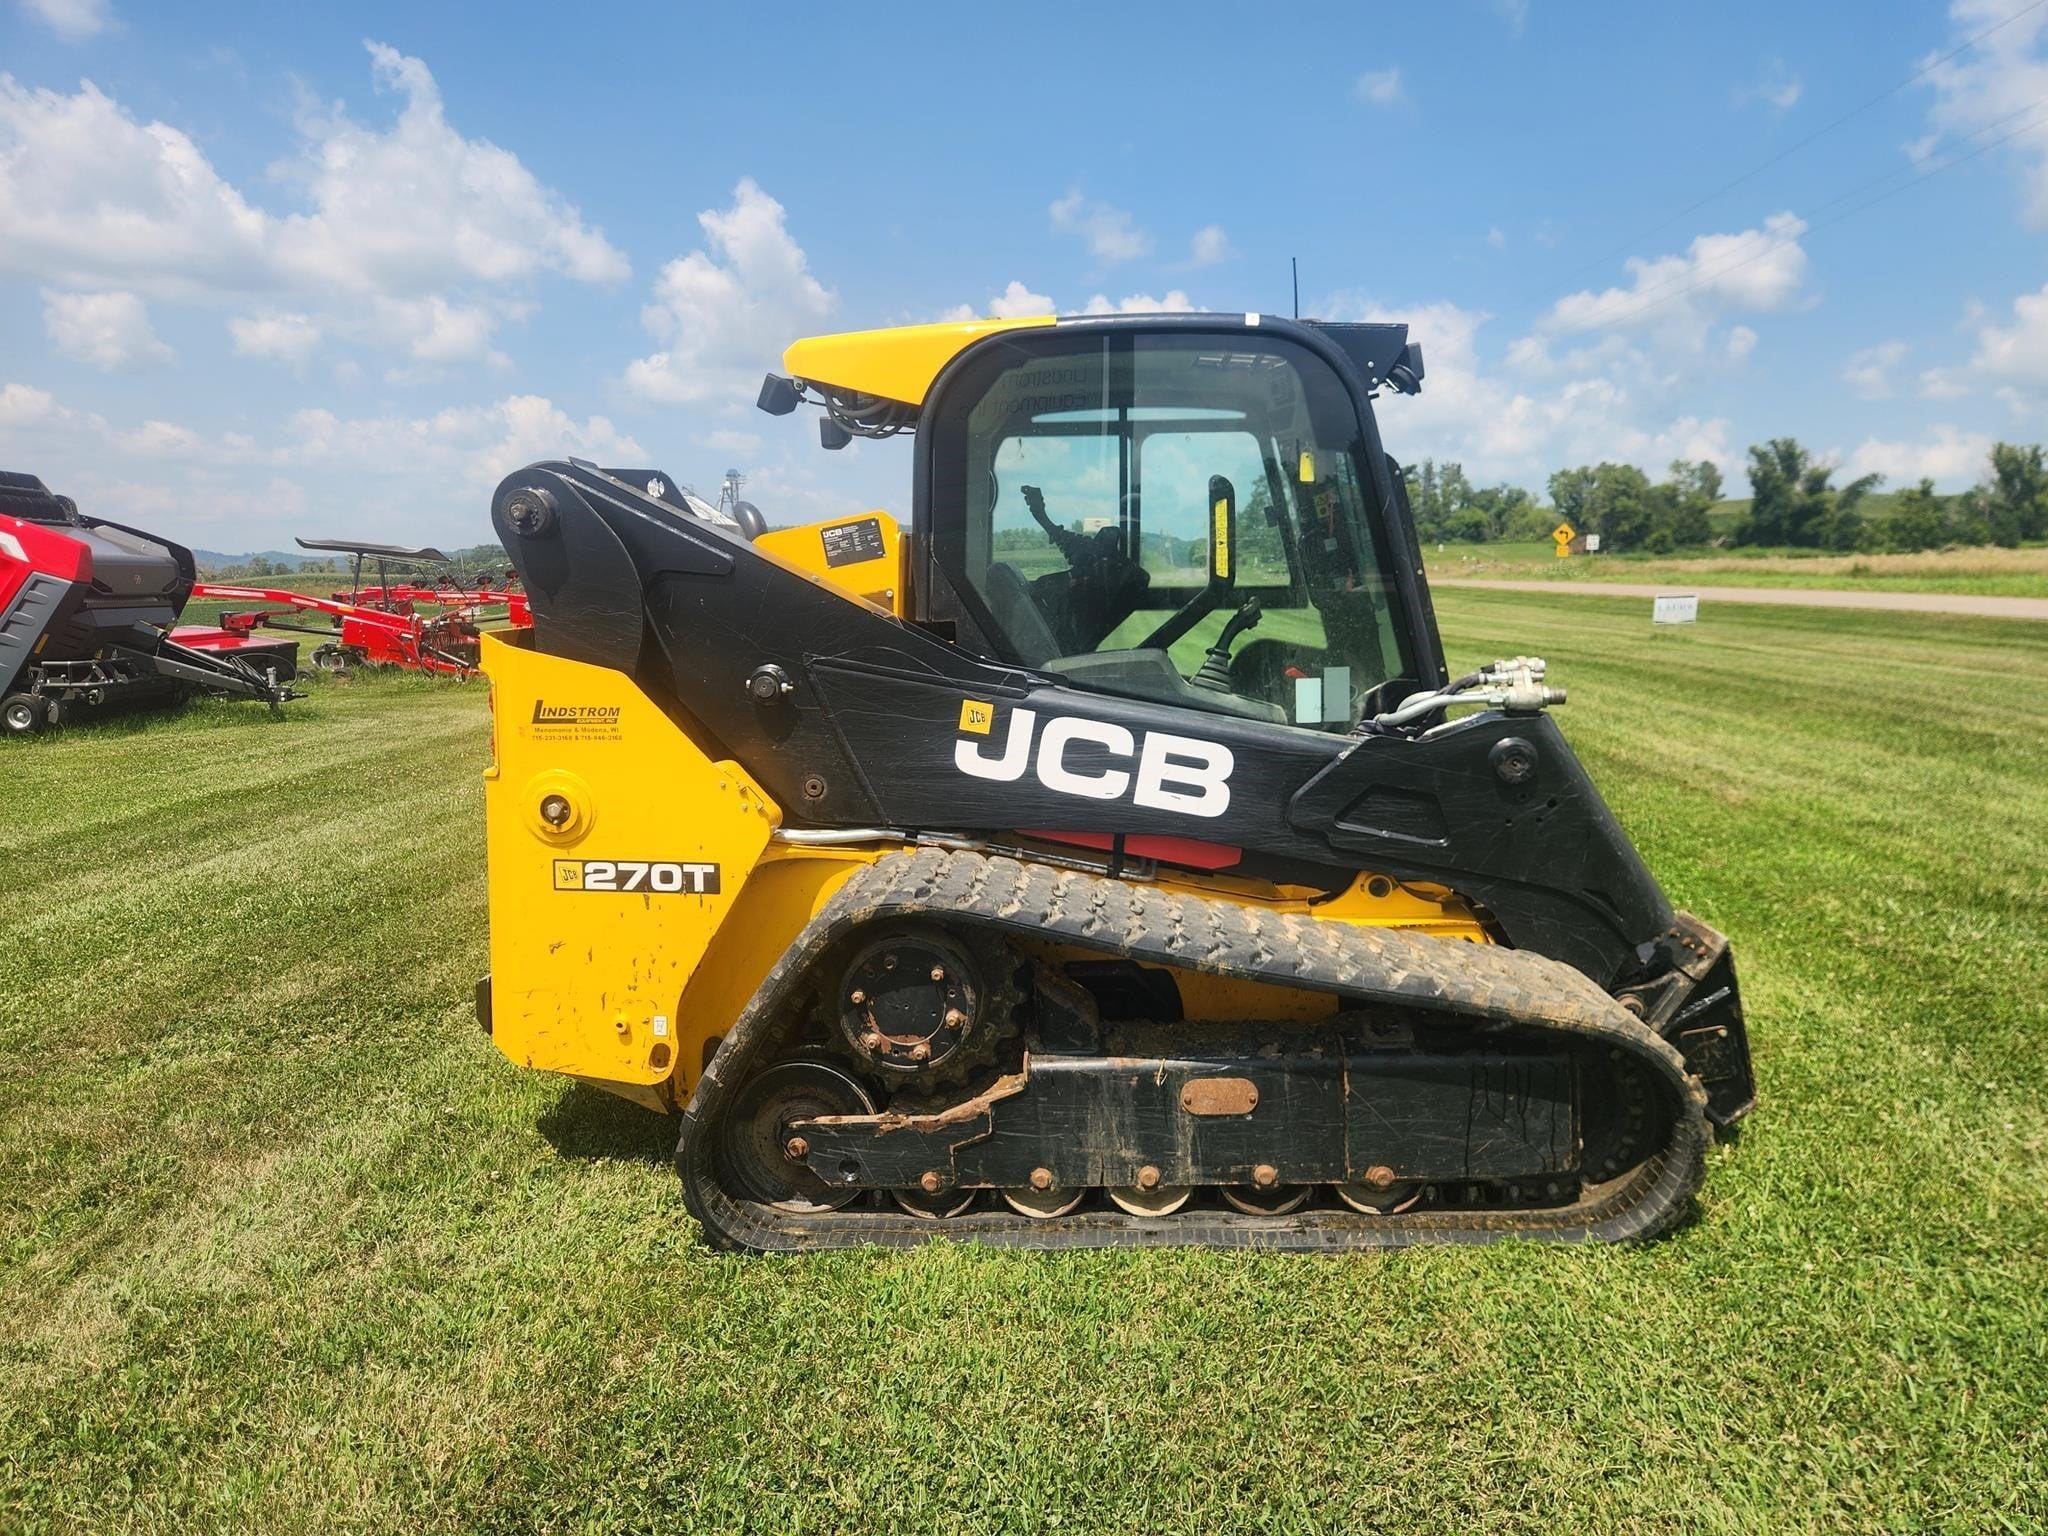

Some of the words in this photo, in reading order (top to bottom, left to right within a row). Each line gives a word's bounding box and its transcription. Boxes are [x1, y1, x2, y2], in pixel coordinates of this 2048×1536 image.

[823, 529, 843, 538] JCB
[532, 700, 620, 724] LINDSTROM
[968, 708, 986, 724] JCB
[954, 708, 1235, 818] JCB
[562, 868, 578, 882] JCB
[584, 861, 715, 892] 270T
